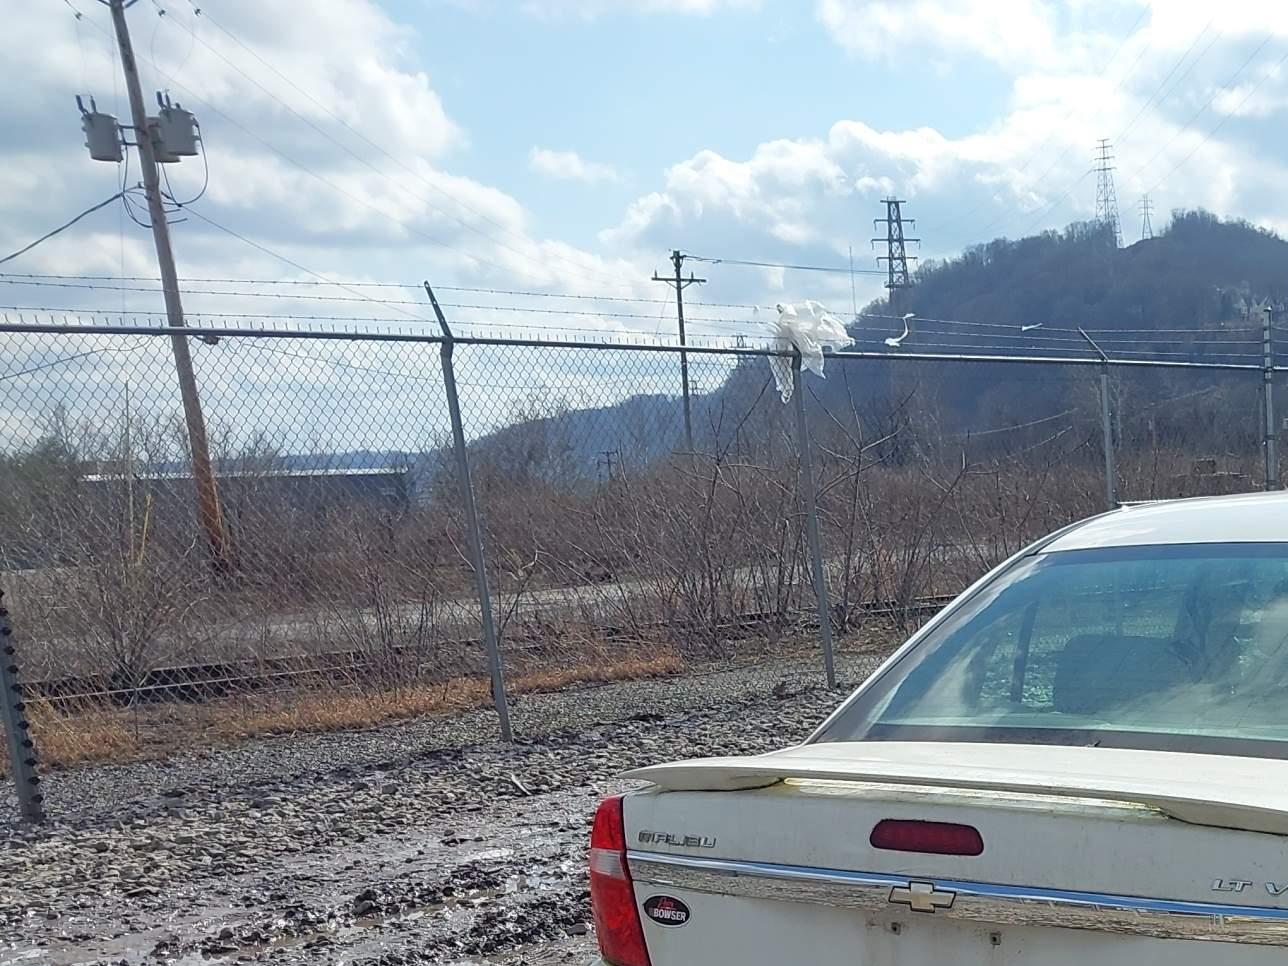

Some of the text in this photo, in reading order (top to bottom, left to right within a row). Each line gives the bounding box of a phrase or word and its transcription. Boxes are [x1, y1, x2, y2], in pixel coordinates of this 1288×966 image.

[638, 830, 717, 848] MALIBU
[1211, 879, 1252, 892] LT
[653, 908, 687, 921] BOWSER
